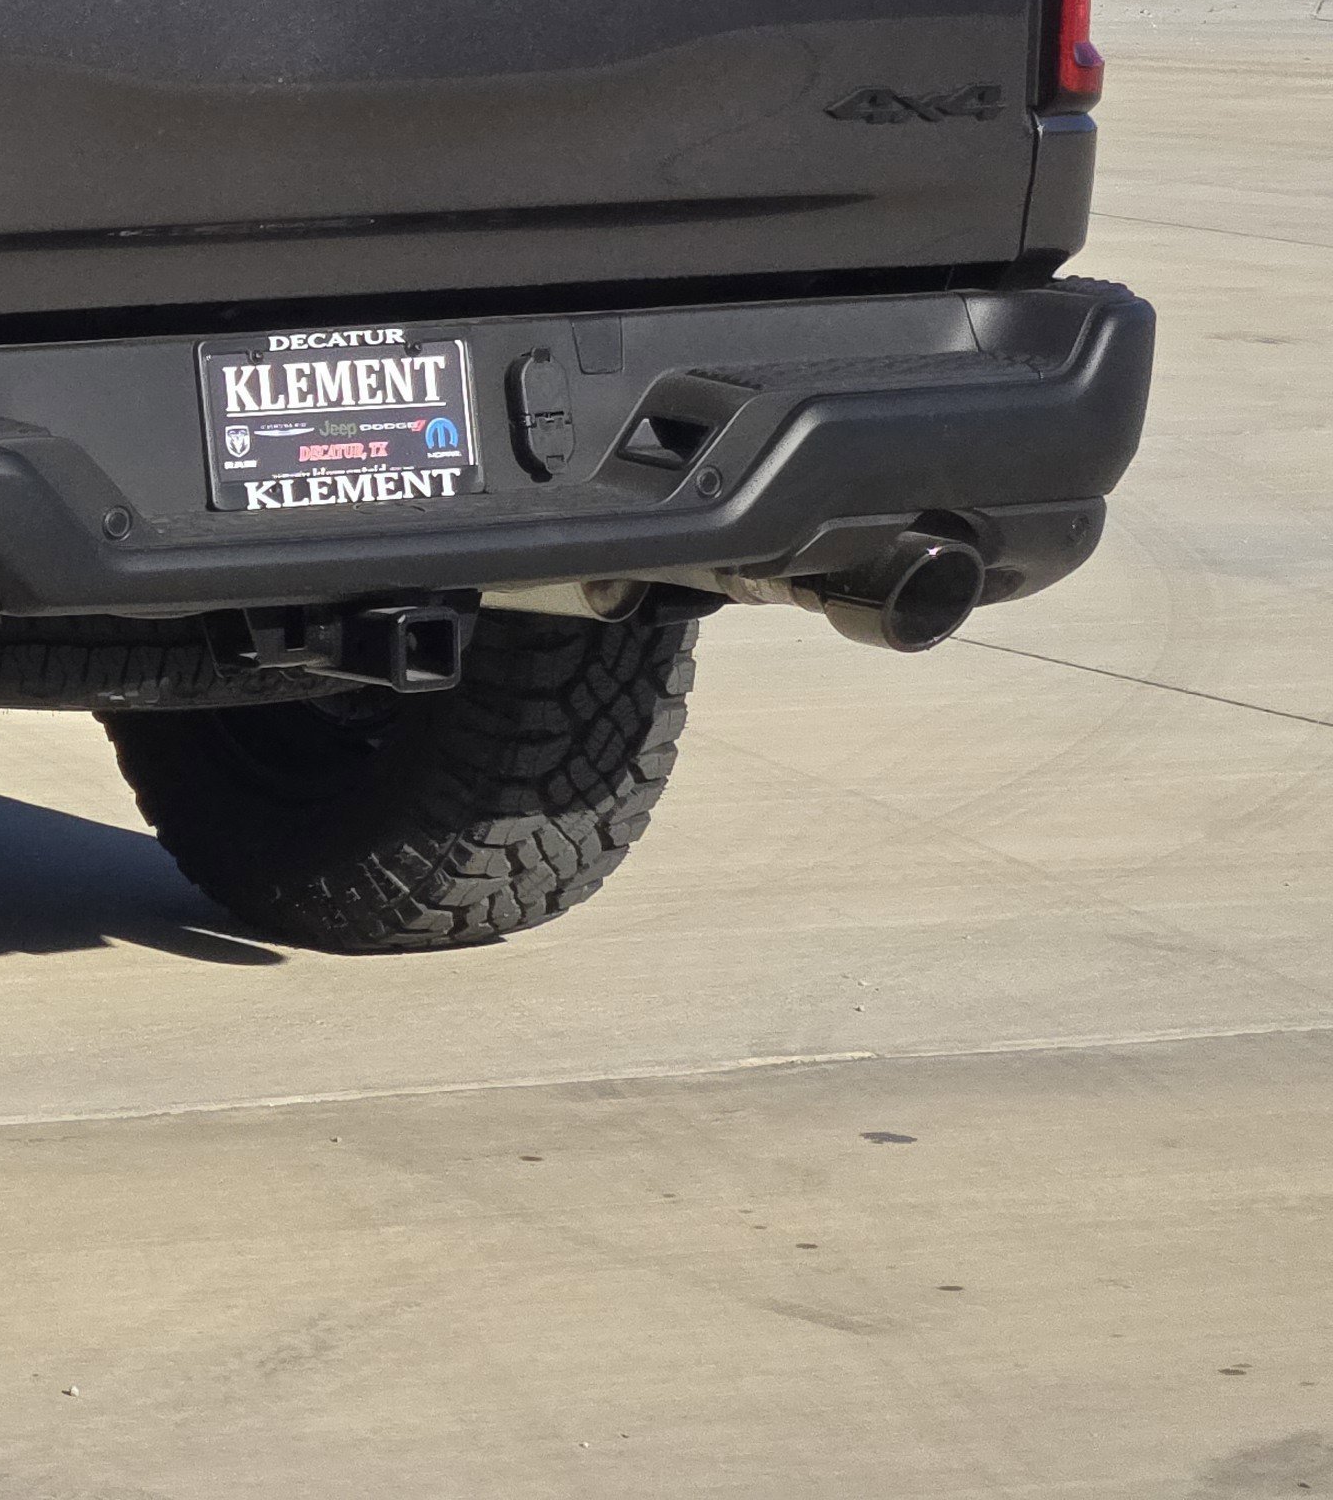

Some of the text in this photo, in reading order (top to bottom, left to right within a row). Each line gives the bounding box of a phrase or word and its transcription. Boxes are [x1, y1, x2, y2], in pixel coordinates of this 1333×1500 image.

[268, 328, 406, 352] DECATUR
[222, 355, 446, 412] KLEMENT
[319, 420, 357, 439] Jeep
[369, 441, 389, 457] TX
[244, 468, 461, 510] KLEMENT
